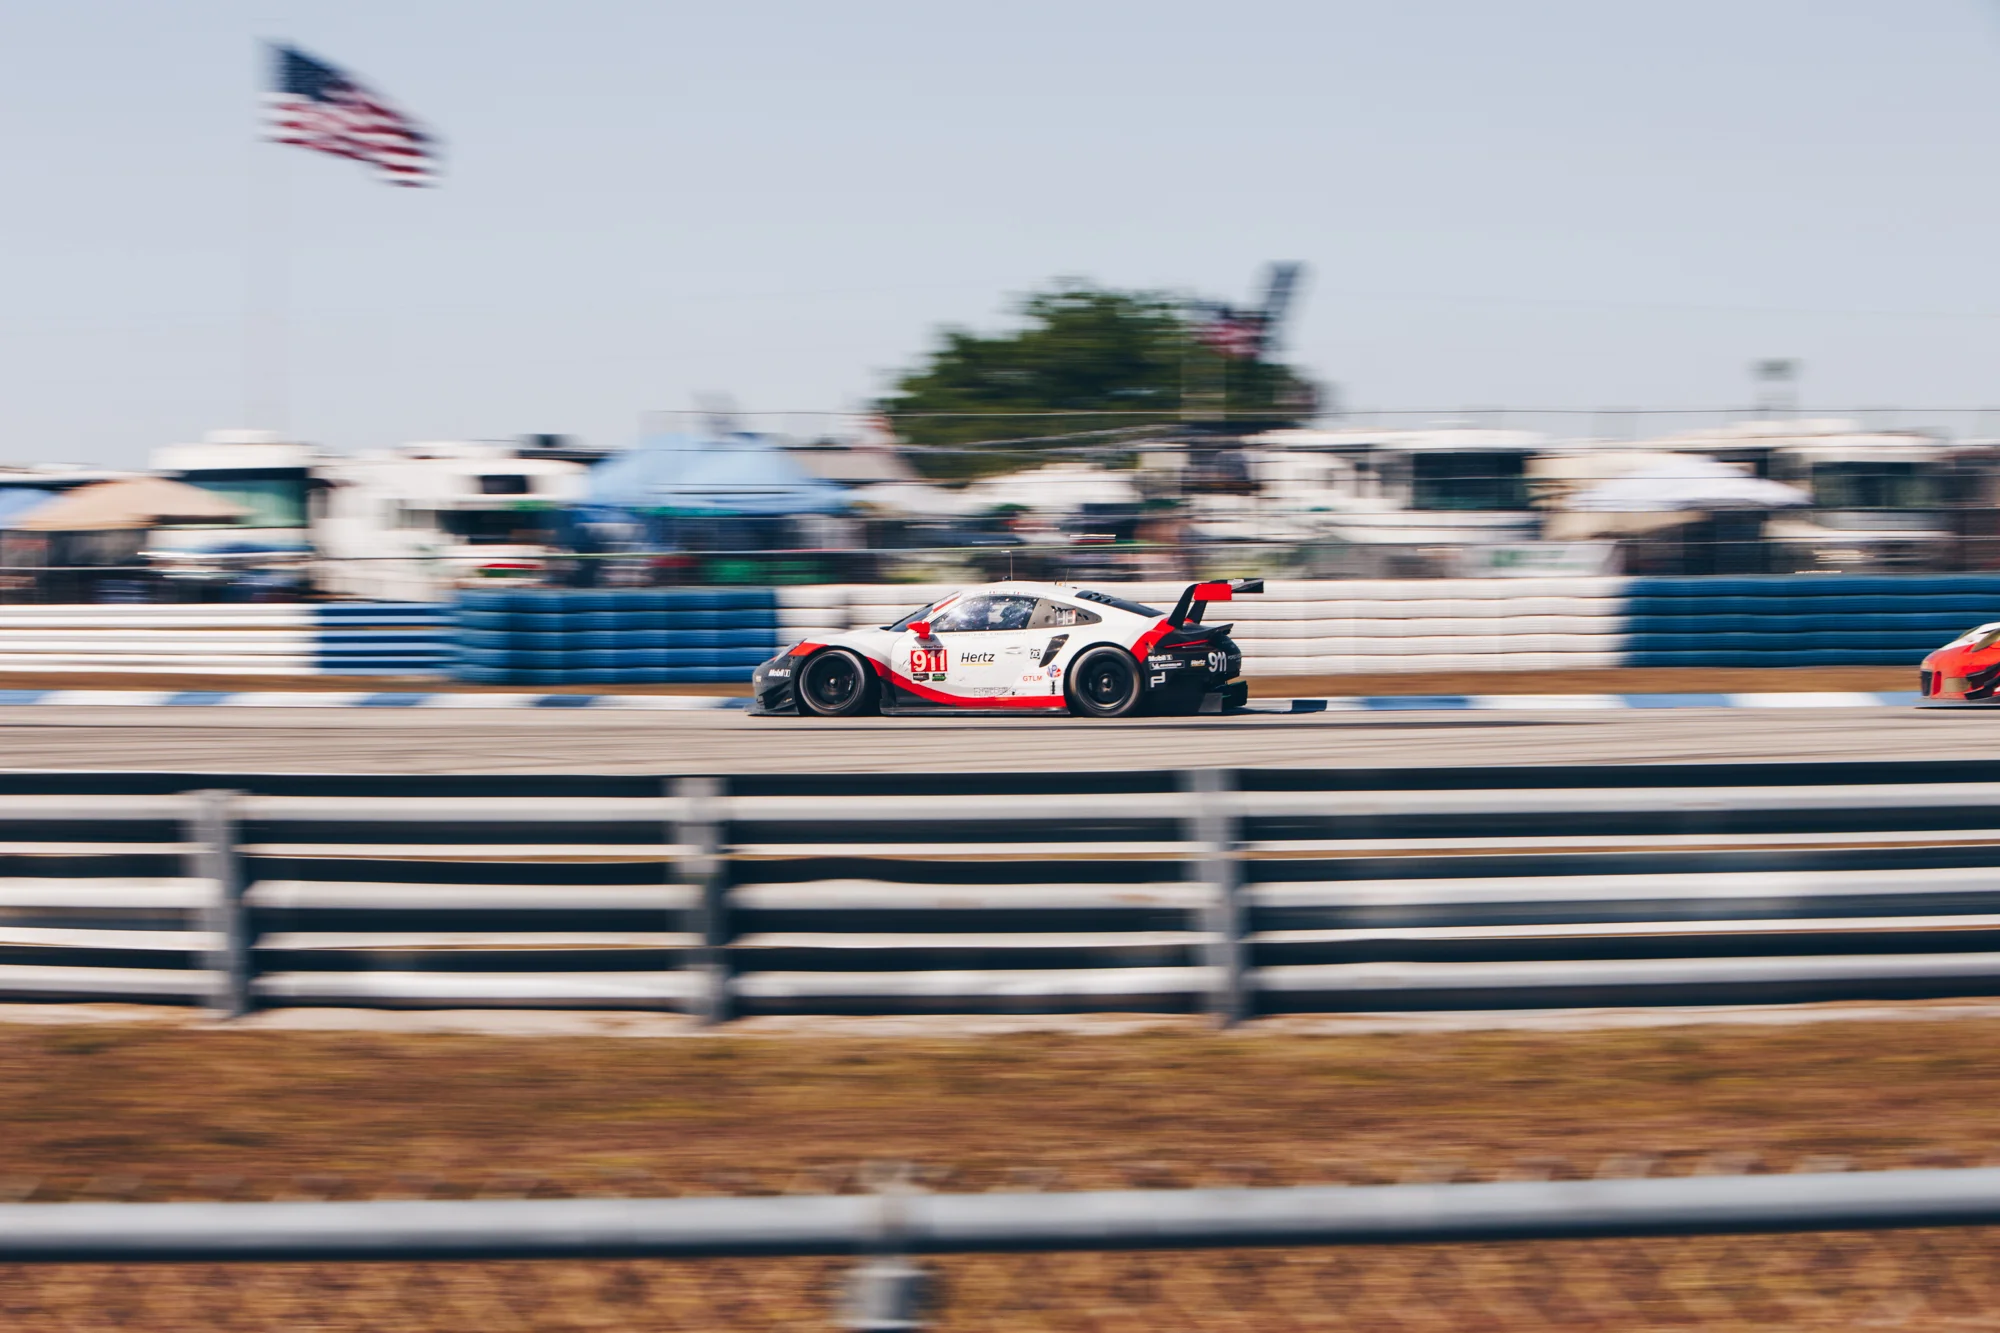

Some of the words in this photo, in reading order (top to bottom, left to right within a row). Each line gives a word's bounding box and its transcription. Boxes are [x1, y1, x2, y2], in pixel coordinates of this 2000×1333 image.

[912, 650, 946, 672] 911
[961, 652, 995, 662] Hertz
[1208, 651, 1227, 672] 911
[768, 669, 784, 677] Mobil
